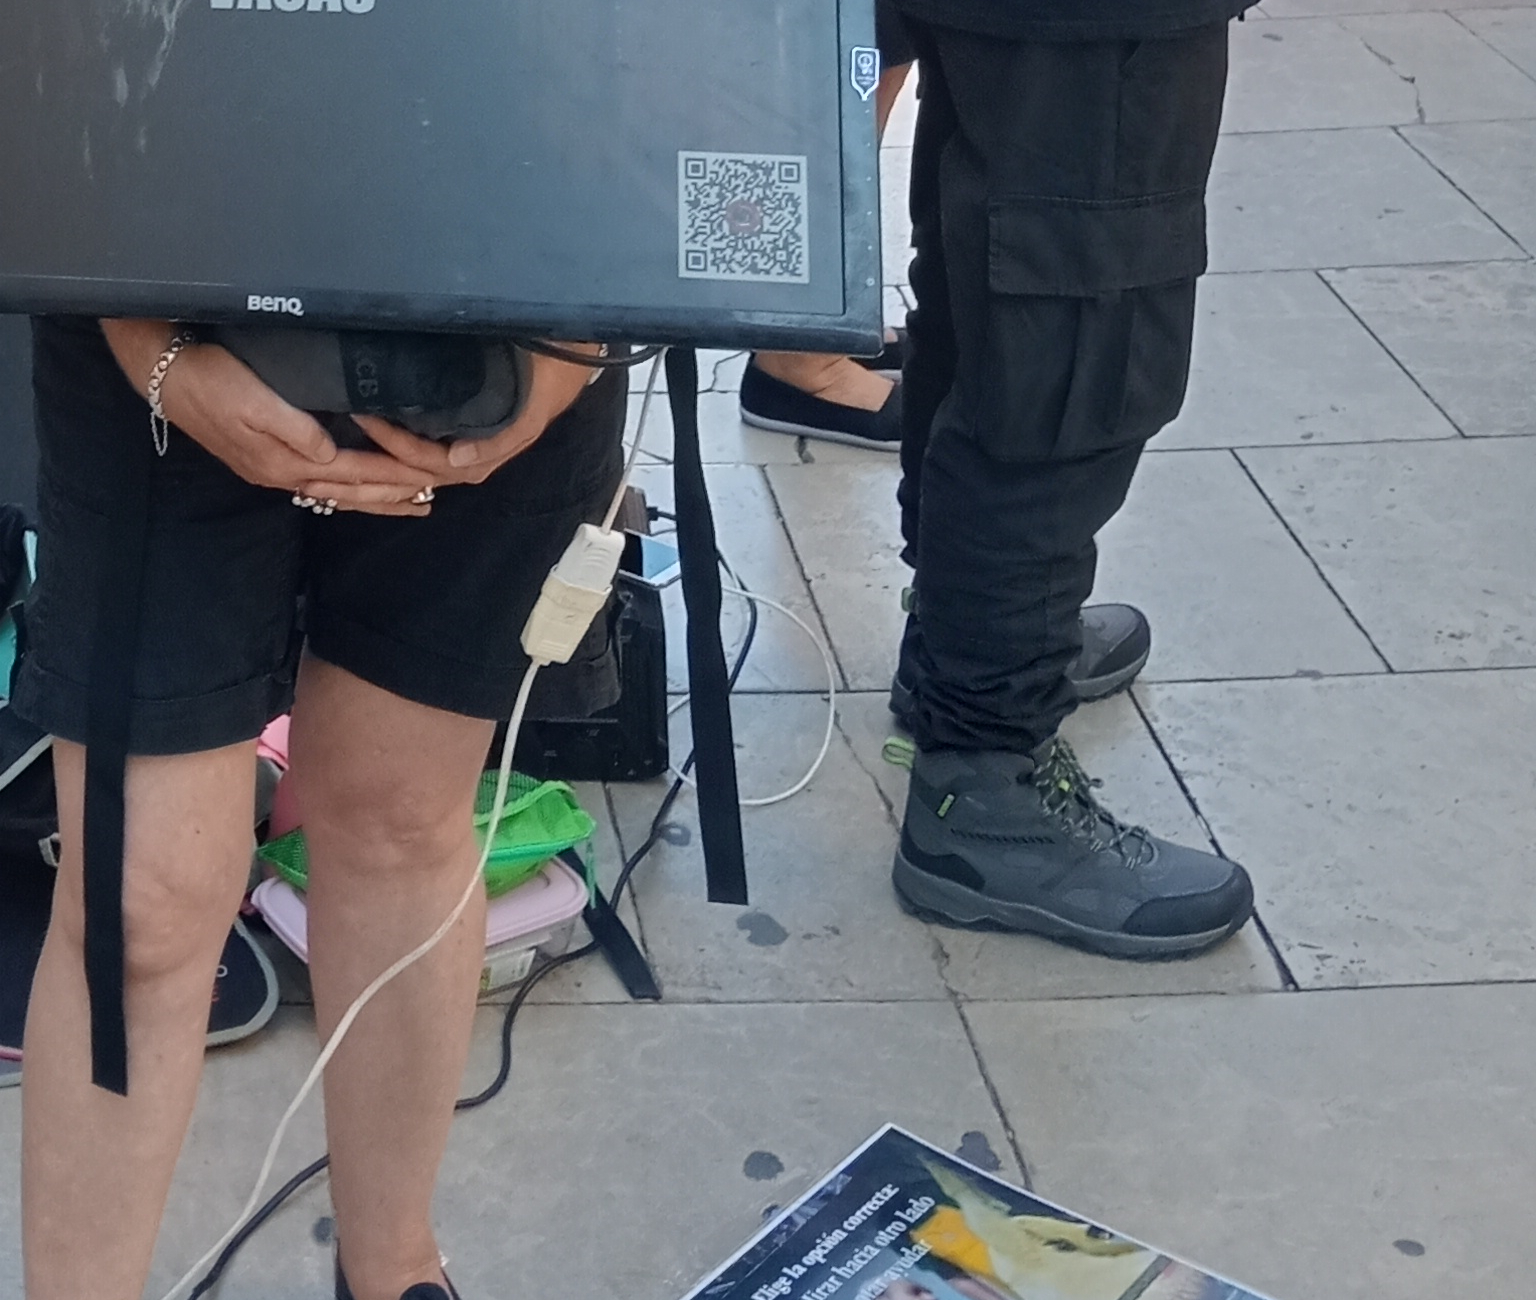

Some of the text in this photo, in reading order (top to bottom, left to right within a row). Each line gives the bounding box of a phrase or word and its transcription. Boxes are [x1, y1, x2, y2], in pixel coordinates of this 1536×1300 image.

[247, 294, 305, 317] BenQ
[781, 1264, 808, 1280] la
[802, 1230, 849, 1264] opción
[843, 1183, 900, 1231] correcta:
[830, 1245, 881, 1279] hacia
[874, 1221, 908, 1249] otro
[894, 1196, 936, 1224] lado
[884, 1239, 934, 1279] ayudar
